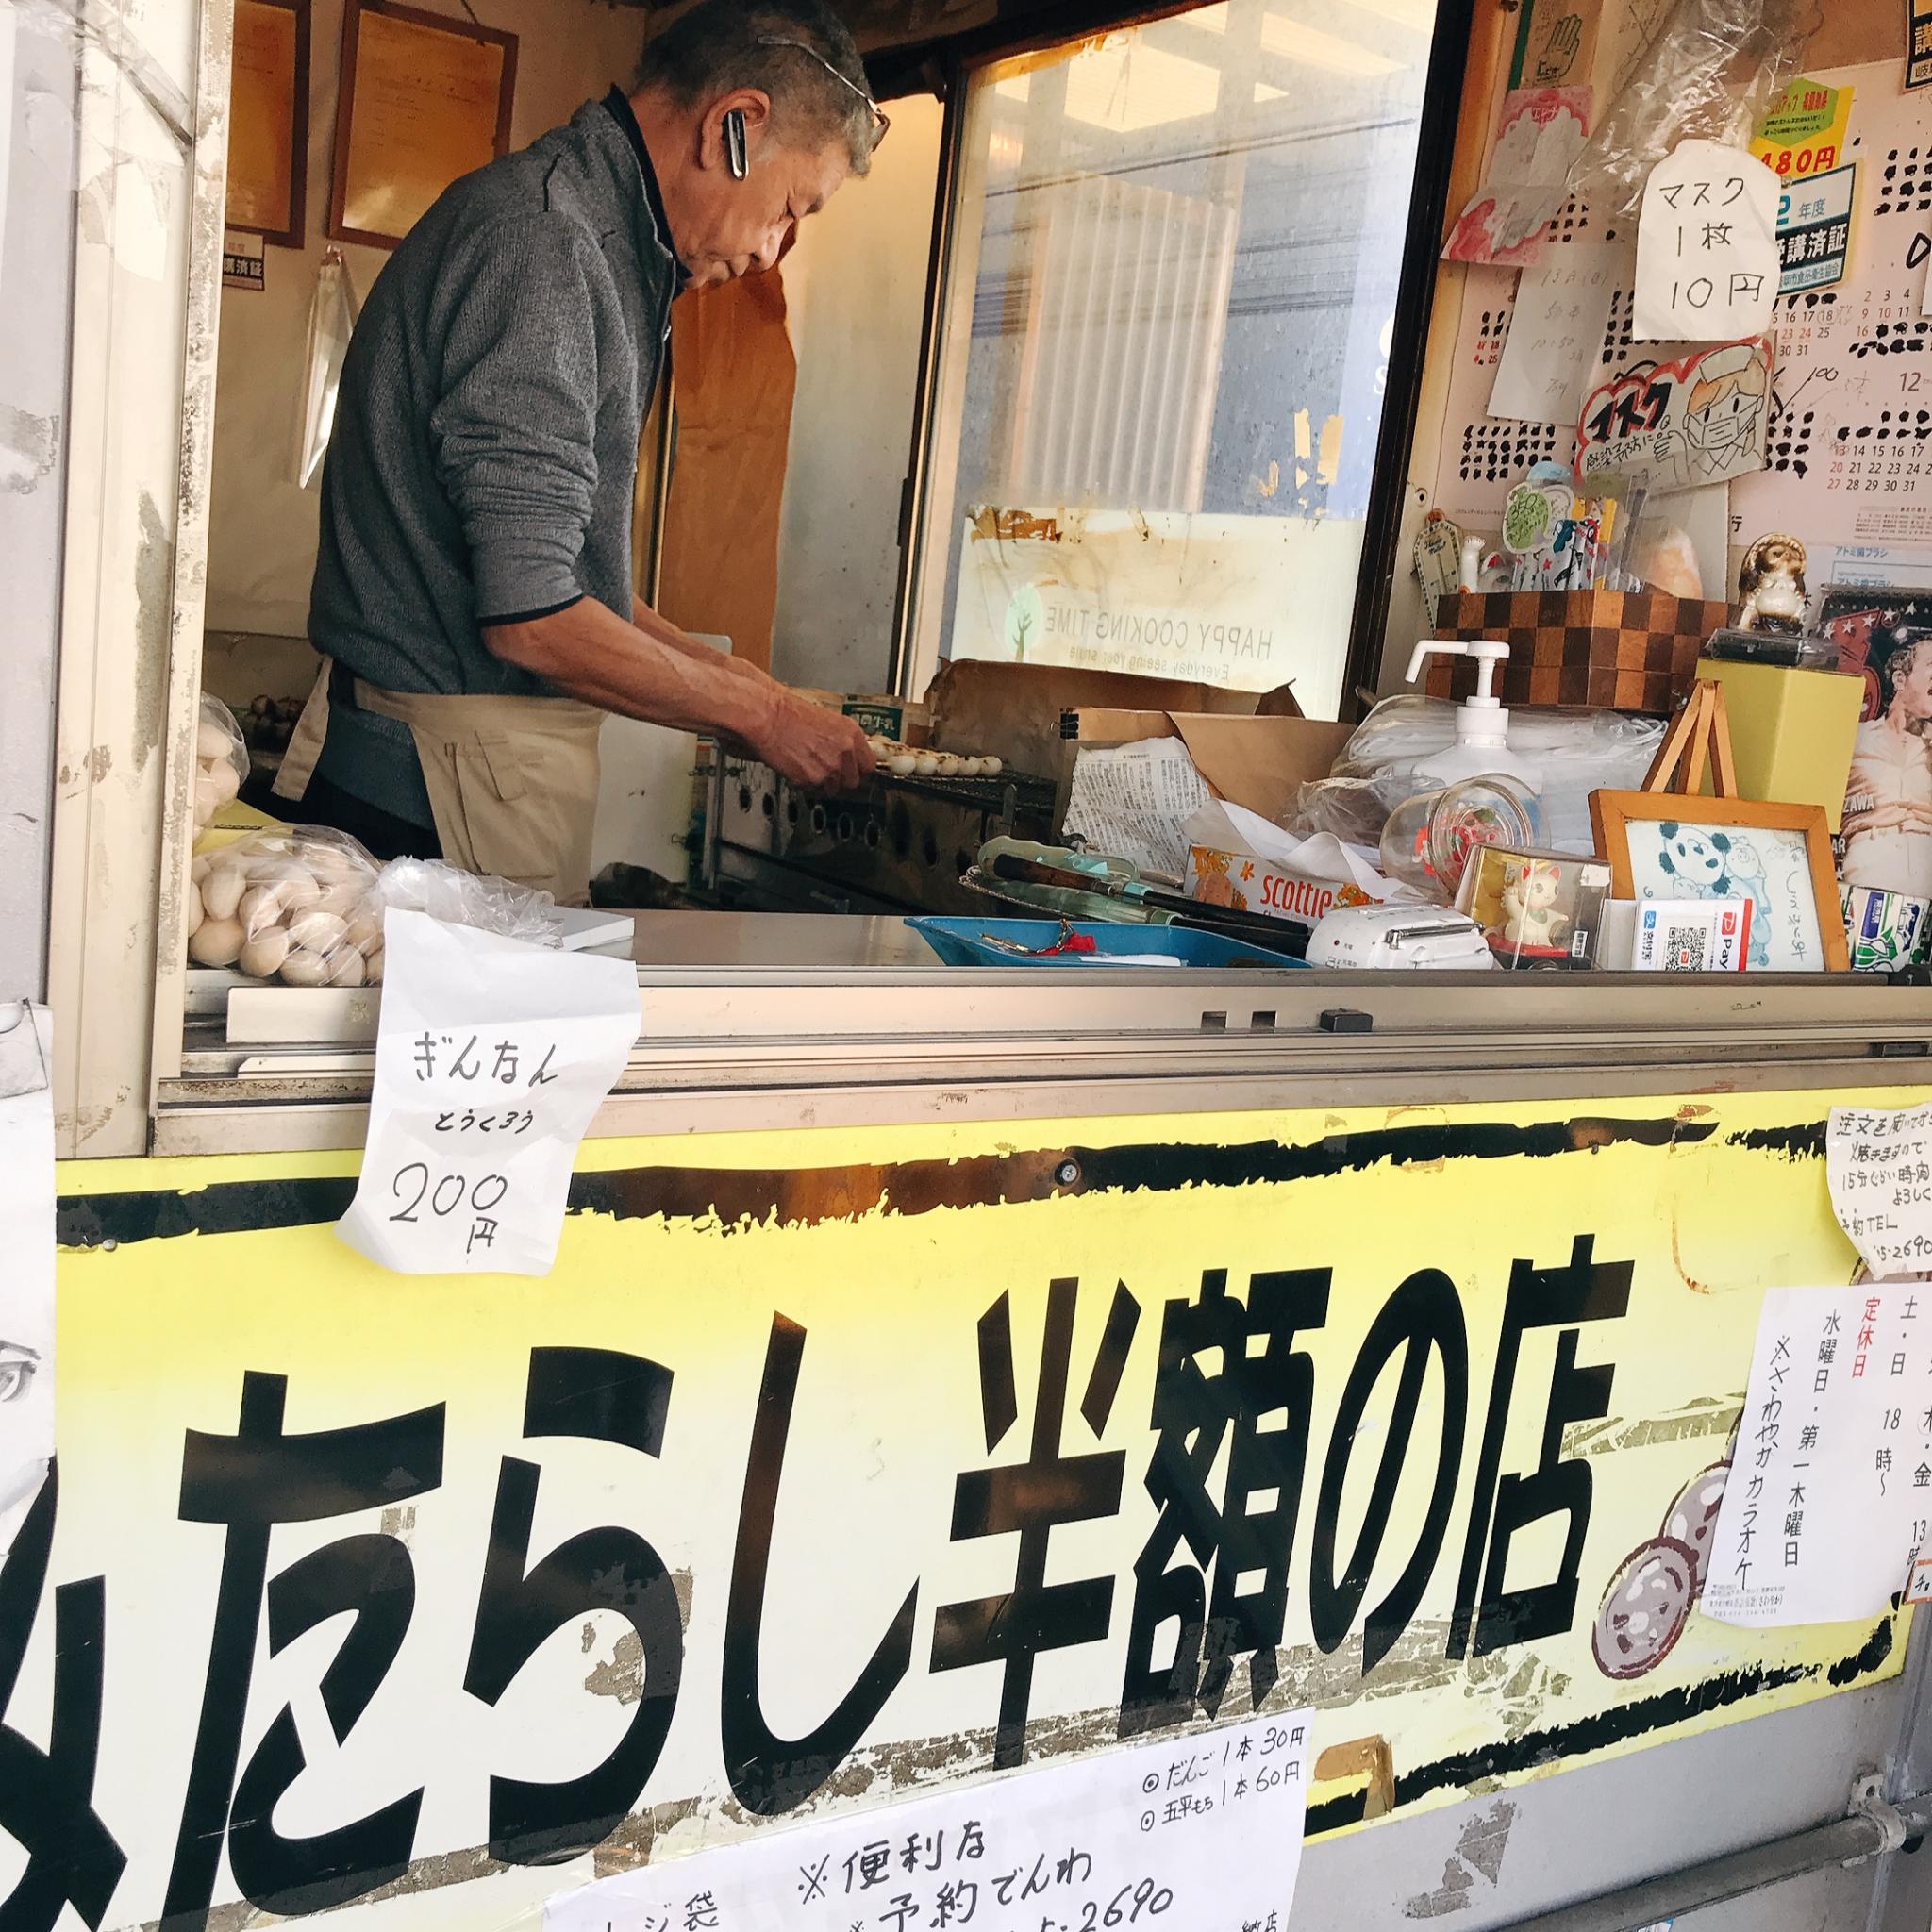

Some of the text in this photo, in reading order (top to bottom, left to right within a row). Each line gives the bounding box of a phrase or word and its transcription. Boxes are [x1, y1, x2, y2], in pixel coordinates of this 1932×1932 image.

[1659, 177, 1744, 209] マスク
[1799, 198, 1826, 220] 年度
[1672, 273, 1765, 309] 10円
[1863, 288, 1910, 302] 2 3 4
[1785, 312, 1796, 323] 16
[1803, 311, 1815, 322] 17
[1820, 310, 1833, 321] 18
[1861, 308, 1869, 319] 9
[1878, 308, 1891, 318] 10
[1898, 307, 1910, 317] 11
[1781, 325, 1869, 340] 23 24 25 16
[1779, 344, 1808, 356] 30 31
[1899, 371, 1922, 391] 12
[1854, 445, 1865, 457] 14
[1873, 445, 1885, 457] 15
[1892, 445, 1905, 457] 16
[1911, 445, 1924, 457] 17
[1830, 461, 1843, 473] 20
[1849, 462, 1862, 474] 21
[1868, 462, 1882, 474] 22
[1888, 462, 1901, 474] 23
[1907, 463, 1920, 475] 24
[1827, 478, 1916, 491] 27 28 29 30 31
[414, 1032, 558, 1088] ぎんなん
[389, 1162, 508, 1223] 200
[1892, 1187, 1932, 1207] よろしく
[466, 1215, 498, 1254] 円
[1851, 1297, 1881, 1378] 定休日
[1784, 1308, 1841, 1568] 水曜日・第一木曜日
[1166, 1750, 1216, 1790] だんご
[1260, 1726, 1305, 1756] 30円
[1161, 1794, 1214, 1824] 五平もち
[1256, 1760, 1300, 1793] 60円
[880, 1847, 1092, 1932] 予約でんわ
